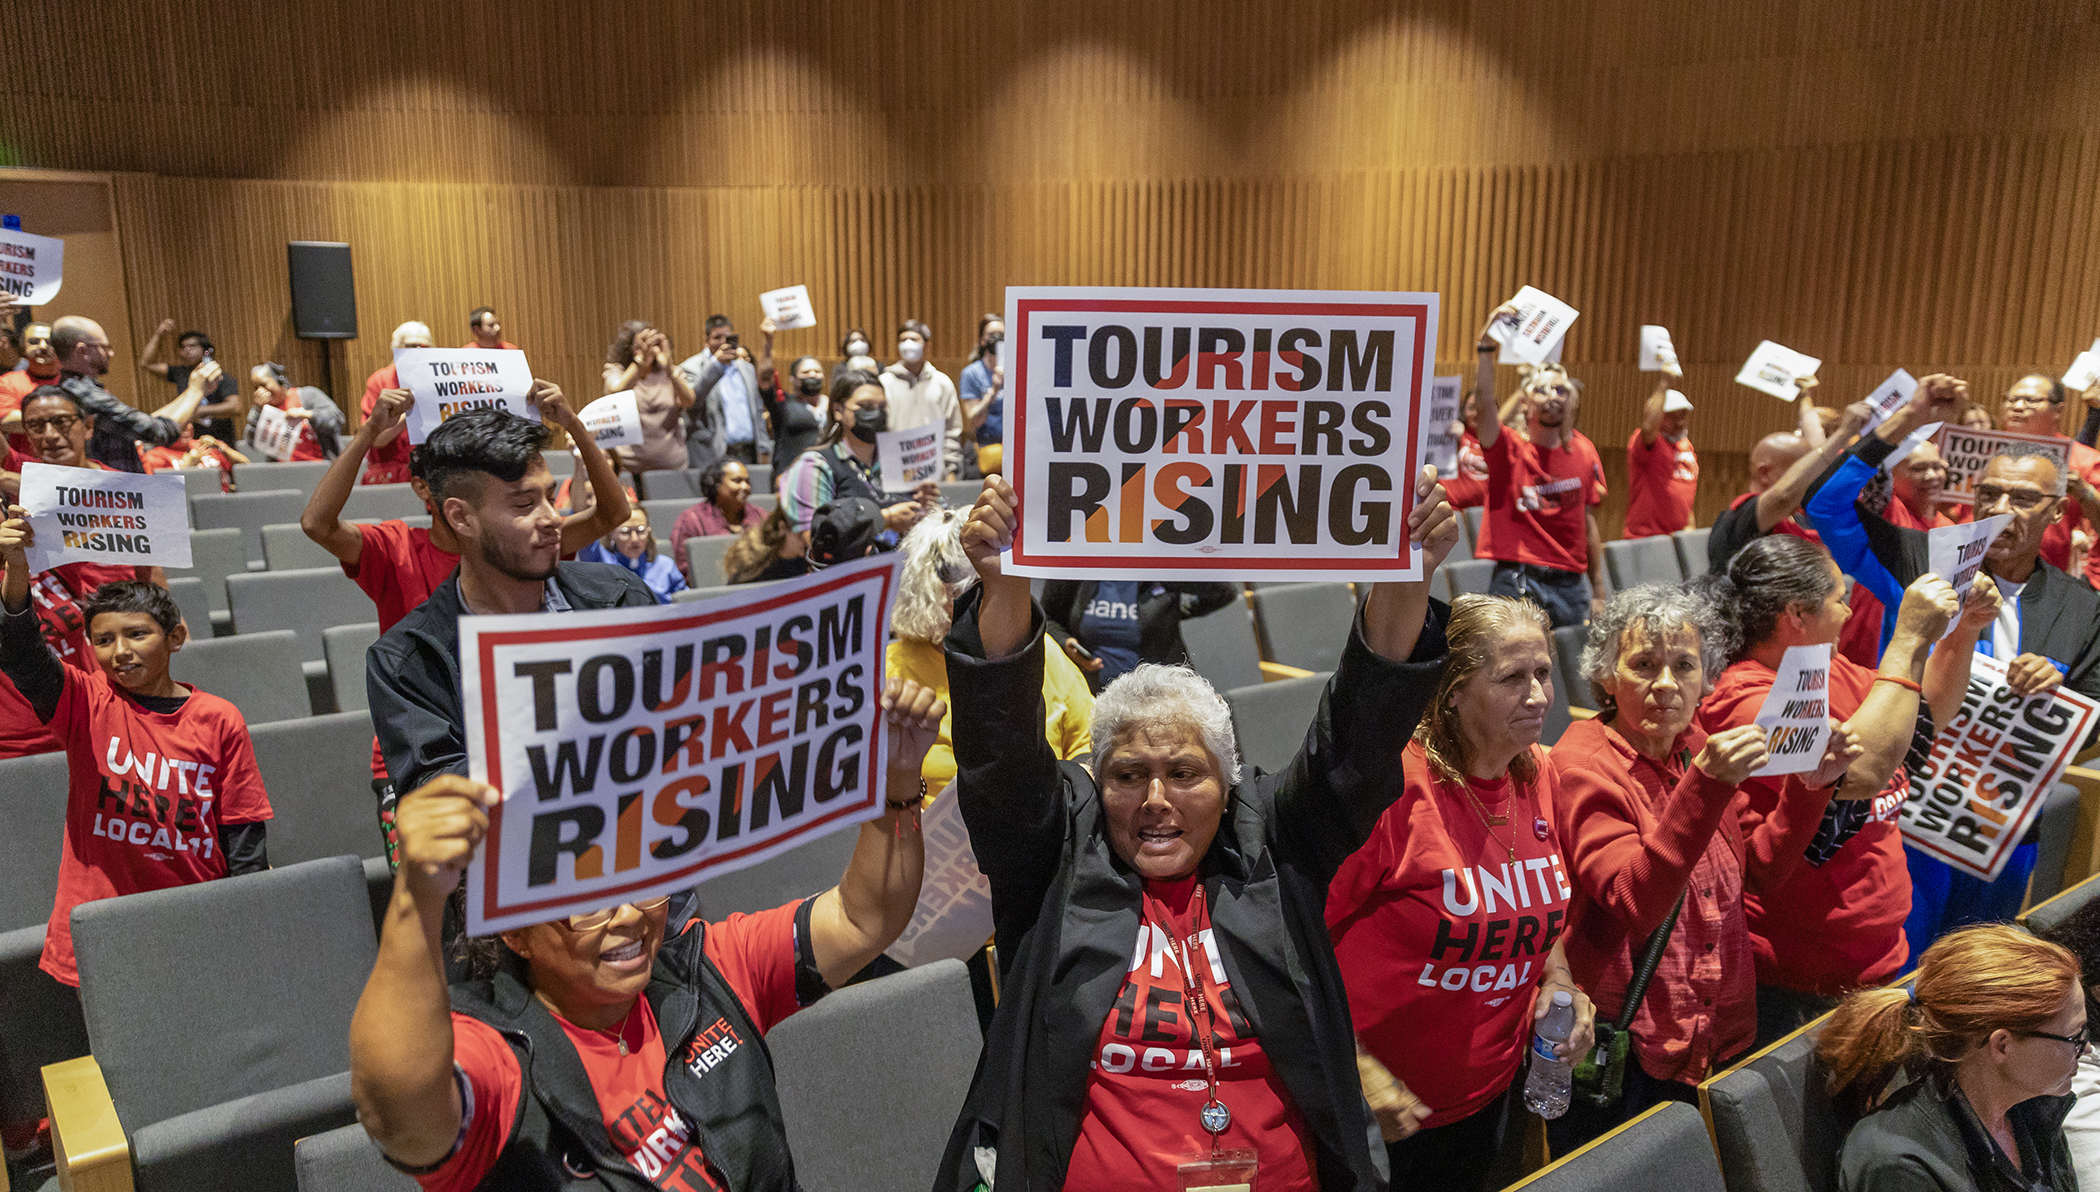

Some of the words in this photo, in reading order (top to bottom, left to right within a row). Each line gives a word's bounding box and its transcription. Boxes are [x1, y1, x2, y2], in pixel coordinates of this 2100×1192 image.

[1041, 324, 1396, 393] TOURISM
[1044, 397, 1392, 457] WORKERS
[55, 486, 144, 509] TOURISM
[56, 512, 147, 529] WORKERS
[1046, 461, 1393, 547] RISING
[62, 529, 151, 554] RISING
[513, 593, 866, 733] TOURISM
[525, 663, 865, 802] WORKERS
[1781, 698, 1825, 720] WORKERS
[106, 736, 216, 797] UNITE
[1767, 725, 1820, 755] RISING
[1914, 685, 2022, 834] WORKERS
[527, 723, 864, 889] RISING
[1947, 697, 2076, 856] RISING
[93, 813, 188, 851] LOCAL
[1442, 854, 1572, 916] UNITE
[1430, 909, 1564, 963] HERE
[1418, 961, 1532, 992] LOCAL
[1090, 1043, 1242, 1074] OCAL
